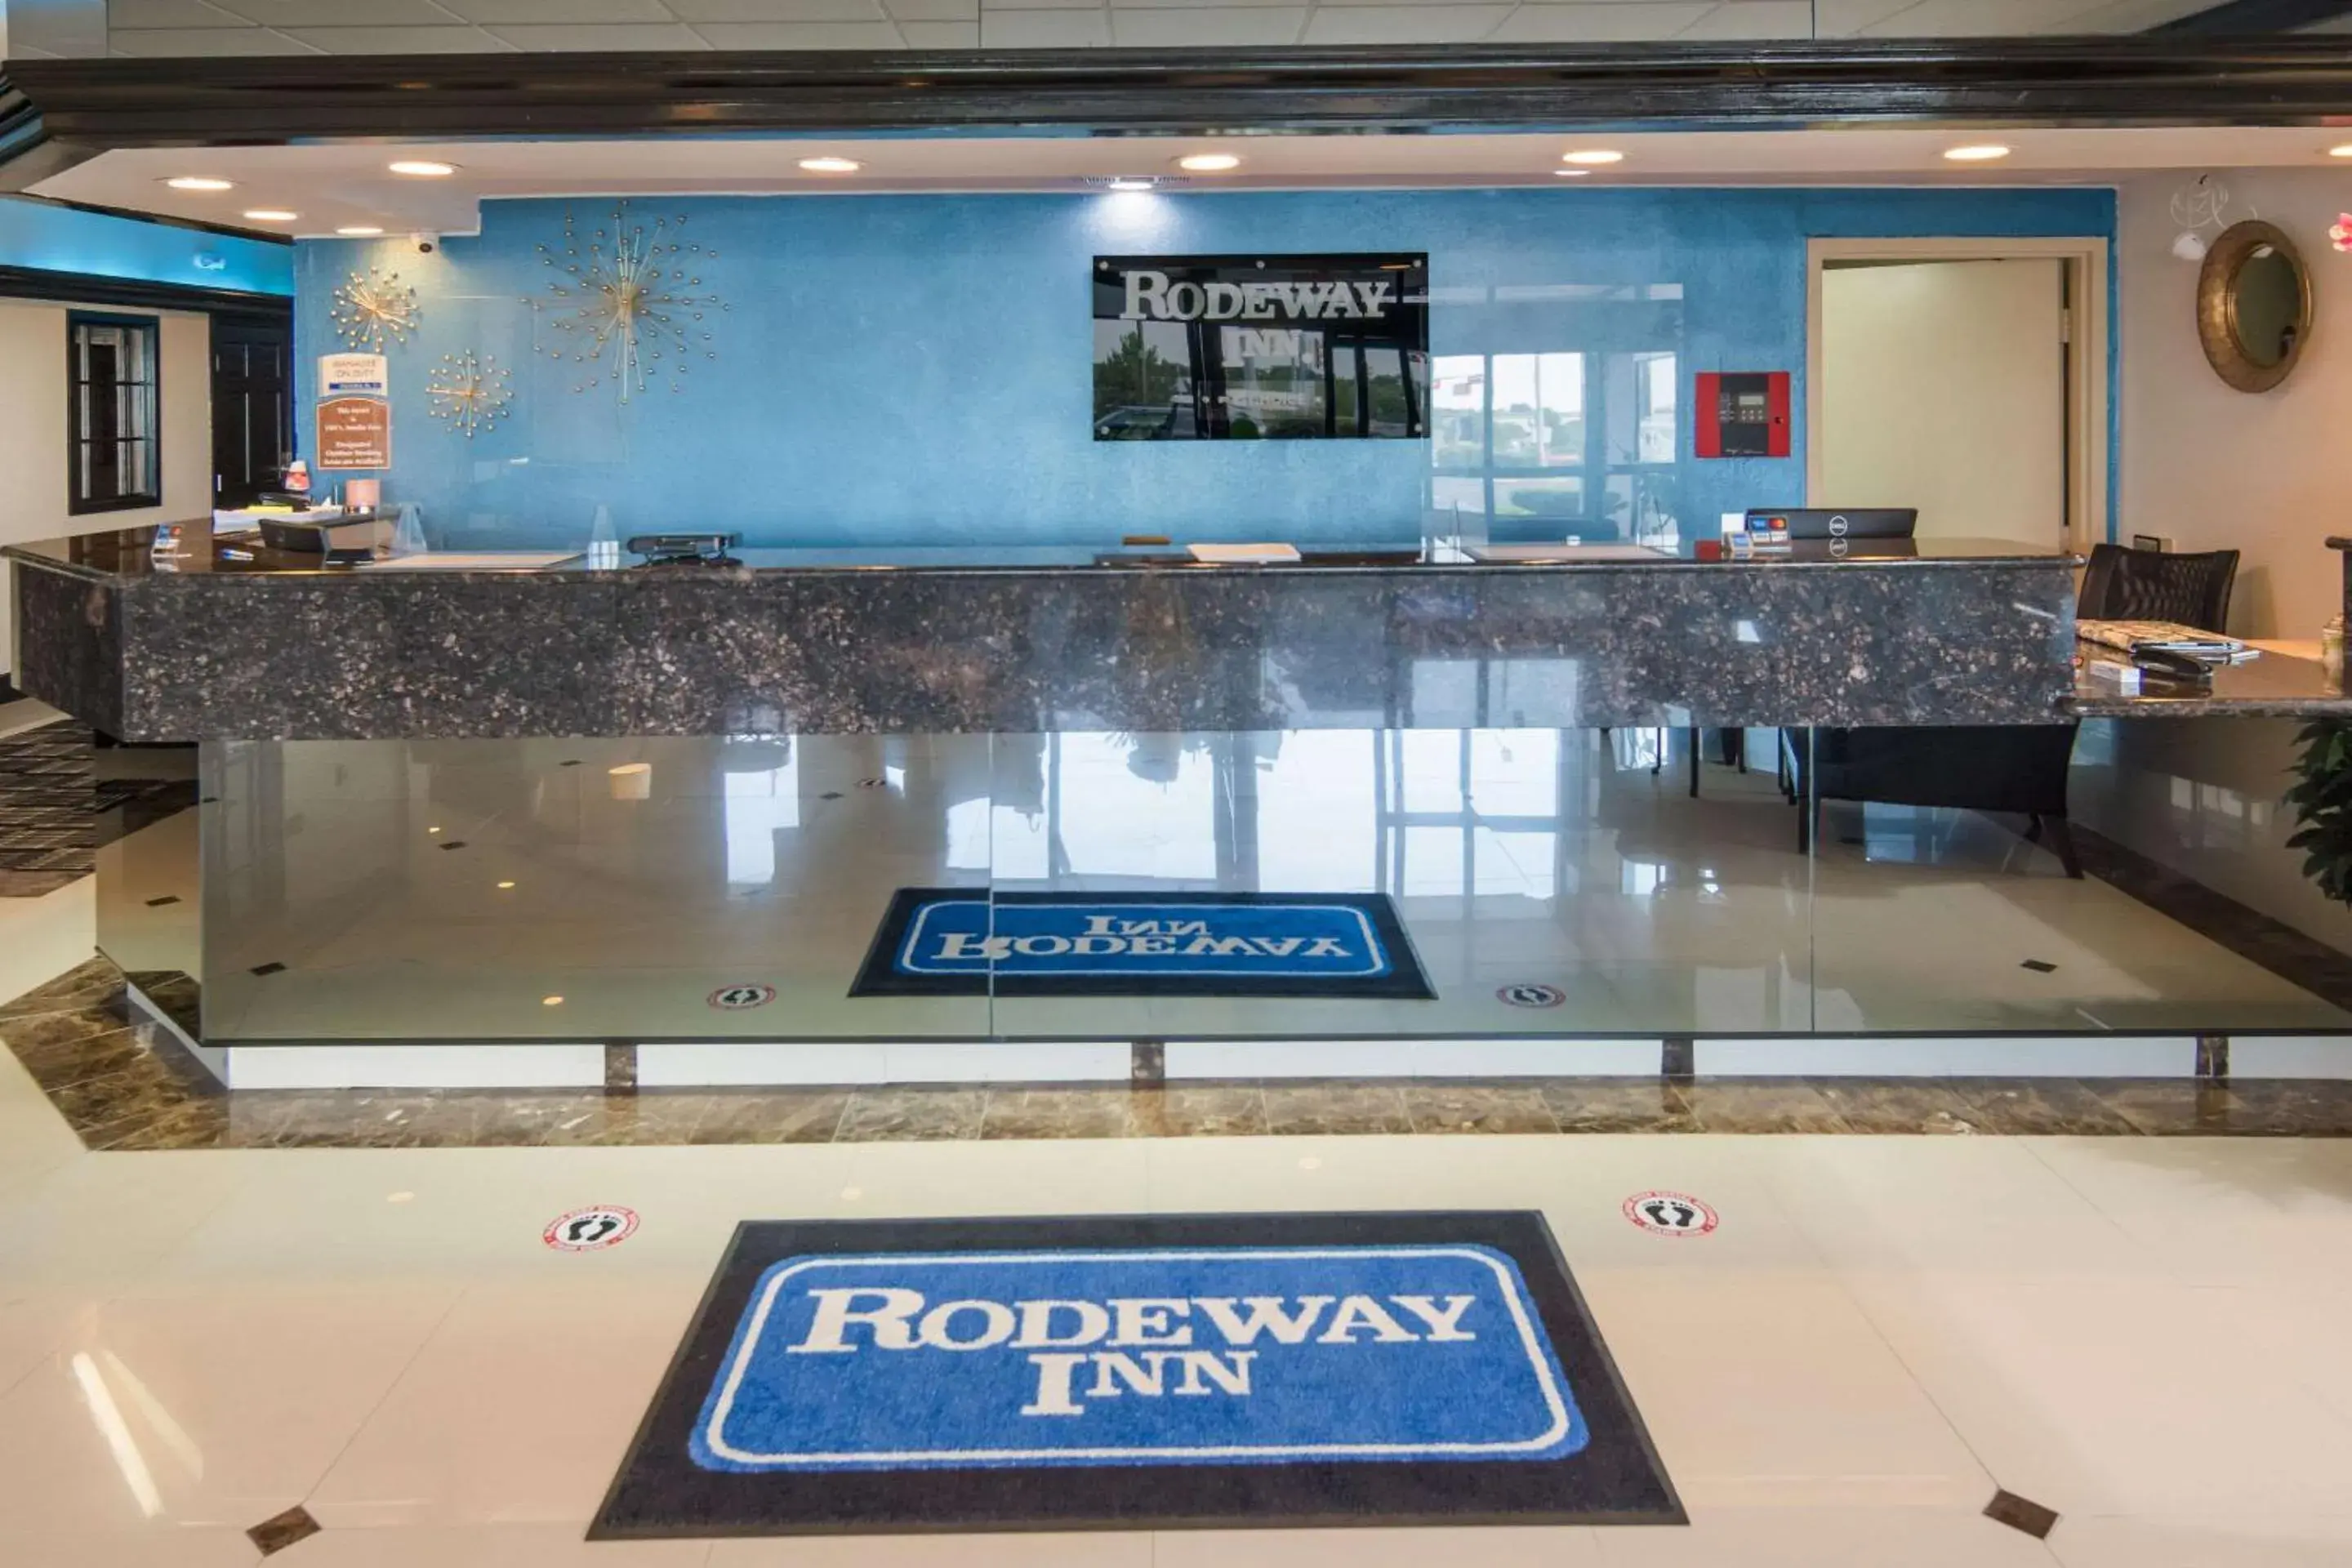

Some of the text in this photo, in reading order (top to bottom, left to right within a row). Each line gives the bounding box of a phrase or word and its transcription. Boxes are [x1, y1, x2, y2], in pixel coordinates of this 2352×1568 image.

[1119, 270, 1390, 321] RODEWAY
[1220, 326, 1302, 368] INN
[786, 1287, 1477, 1354] RODEWAY
[1020, 1350, 1258, 1416] INN
